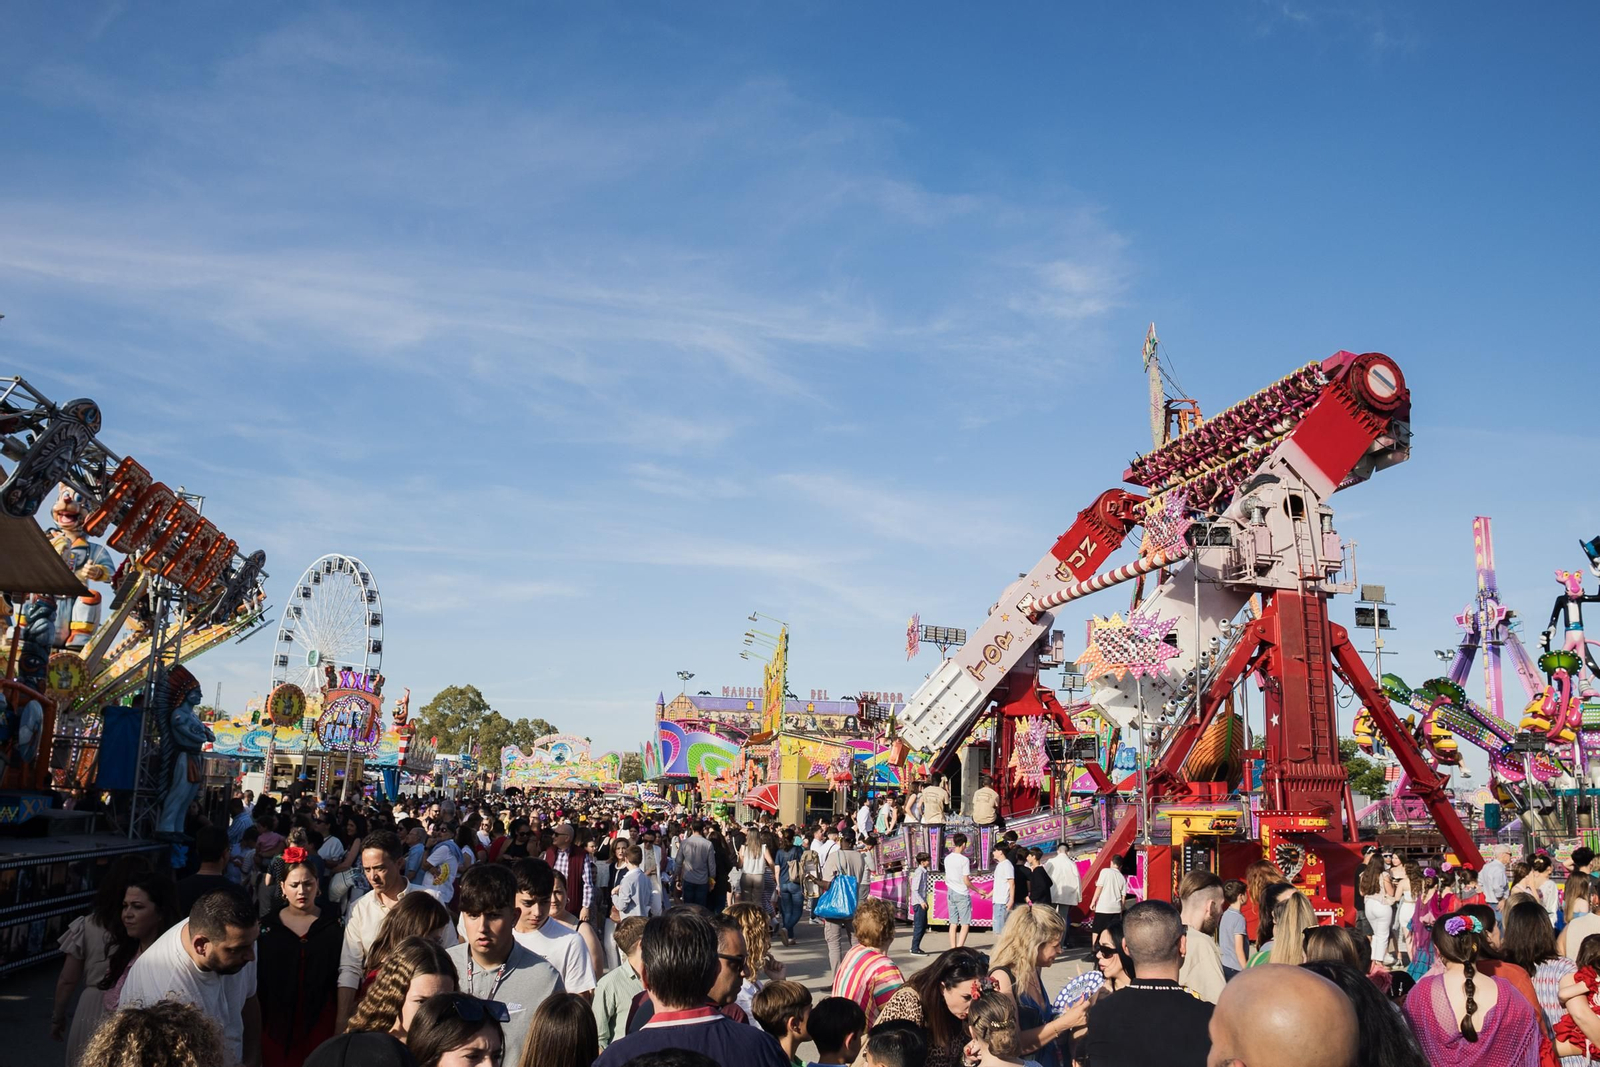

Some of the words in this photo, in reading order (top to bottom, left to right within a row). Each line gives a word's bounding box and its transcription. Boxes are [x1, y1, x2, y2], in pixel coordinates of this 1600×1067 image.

[83, 455, 239, 600] TOTEM
[967, 631, 1015, 682] TOP
[1055, 535, 1098, 583] GUN
[340, 671, 374, 693] XXL
[722, 686, 764, 698] MANSIO
[810, 689, 830, 700] DEL
